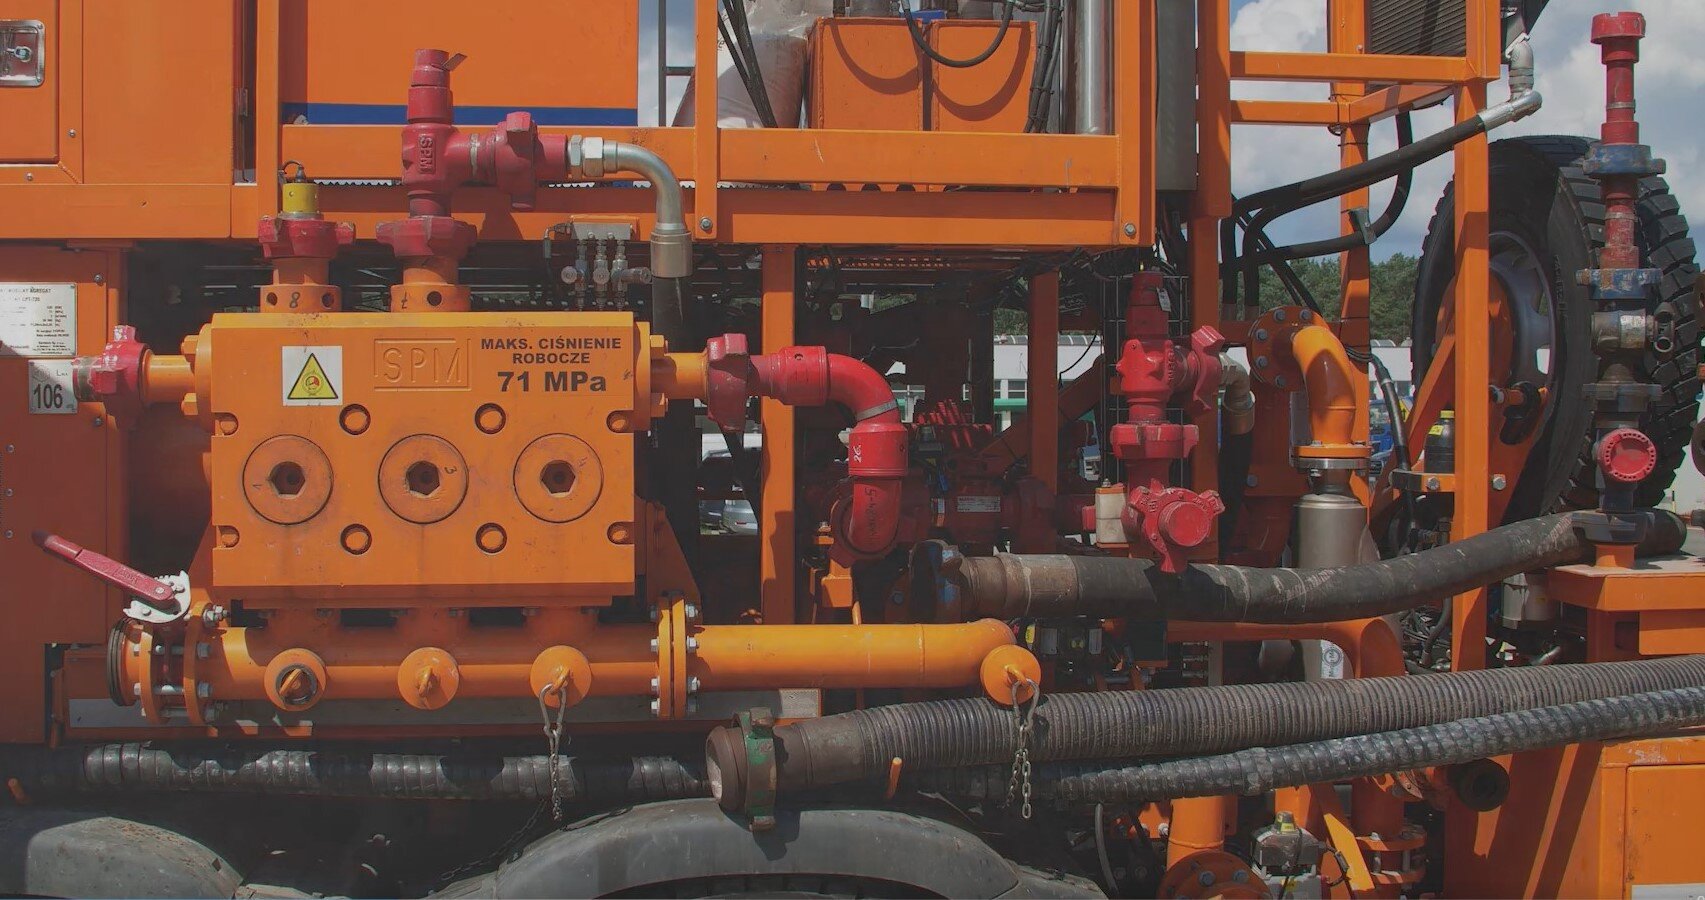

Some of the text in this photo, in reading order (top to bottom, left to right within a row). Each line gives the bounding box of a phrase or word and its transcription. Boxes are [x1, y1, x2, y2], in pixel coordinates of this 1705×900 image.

[481, 335, 622, 350] MAKS. CIŚNIENIE
[383, 347, 462, 383] SPM
[512, 352, 591, 364] ROBOCZE
[497, 371, 607, 392] 71 MPa
[33, 384, 63, 409] 106
